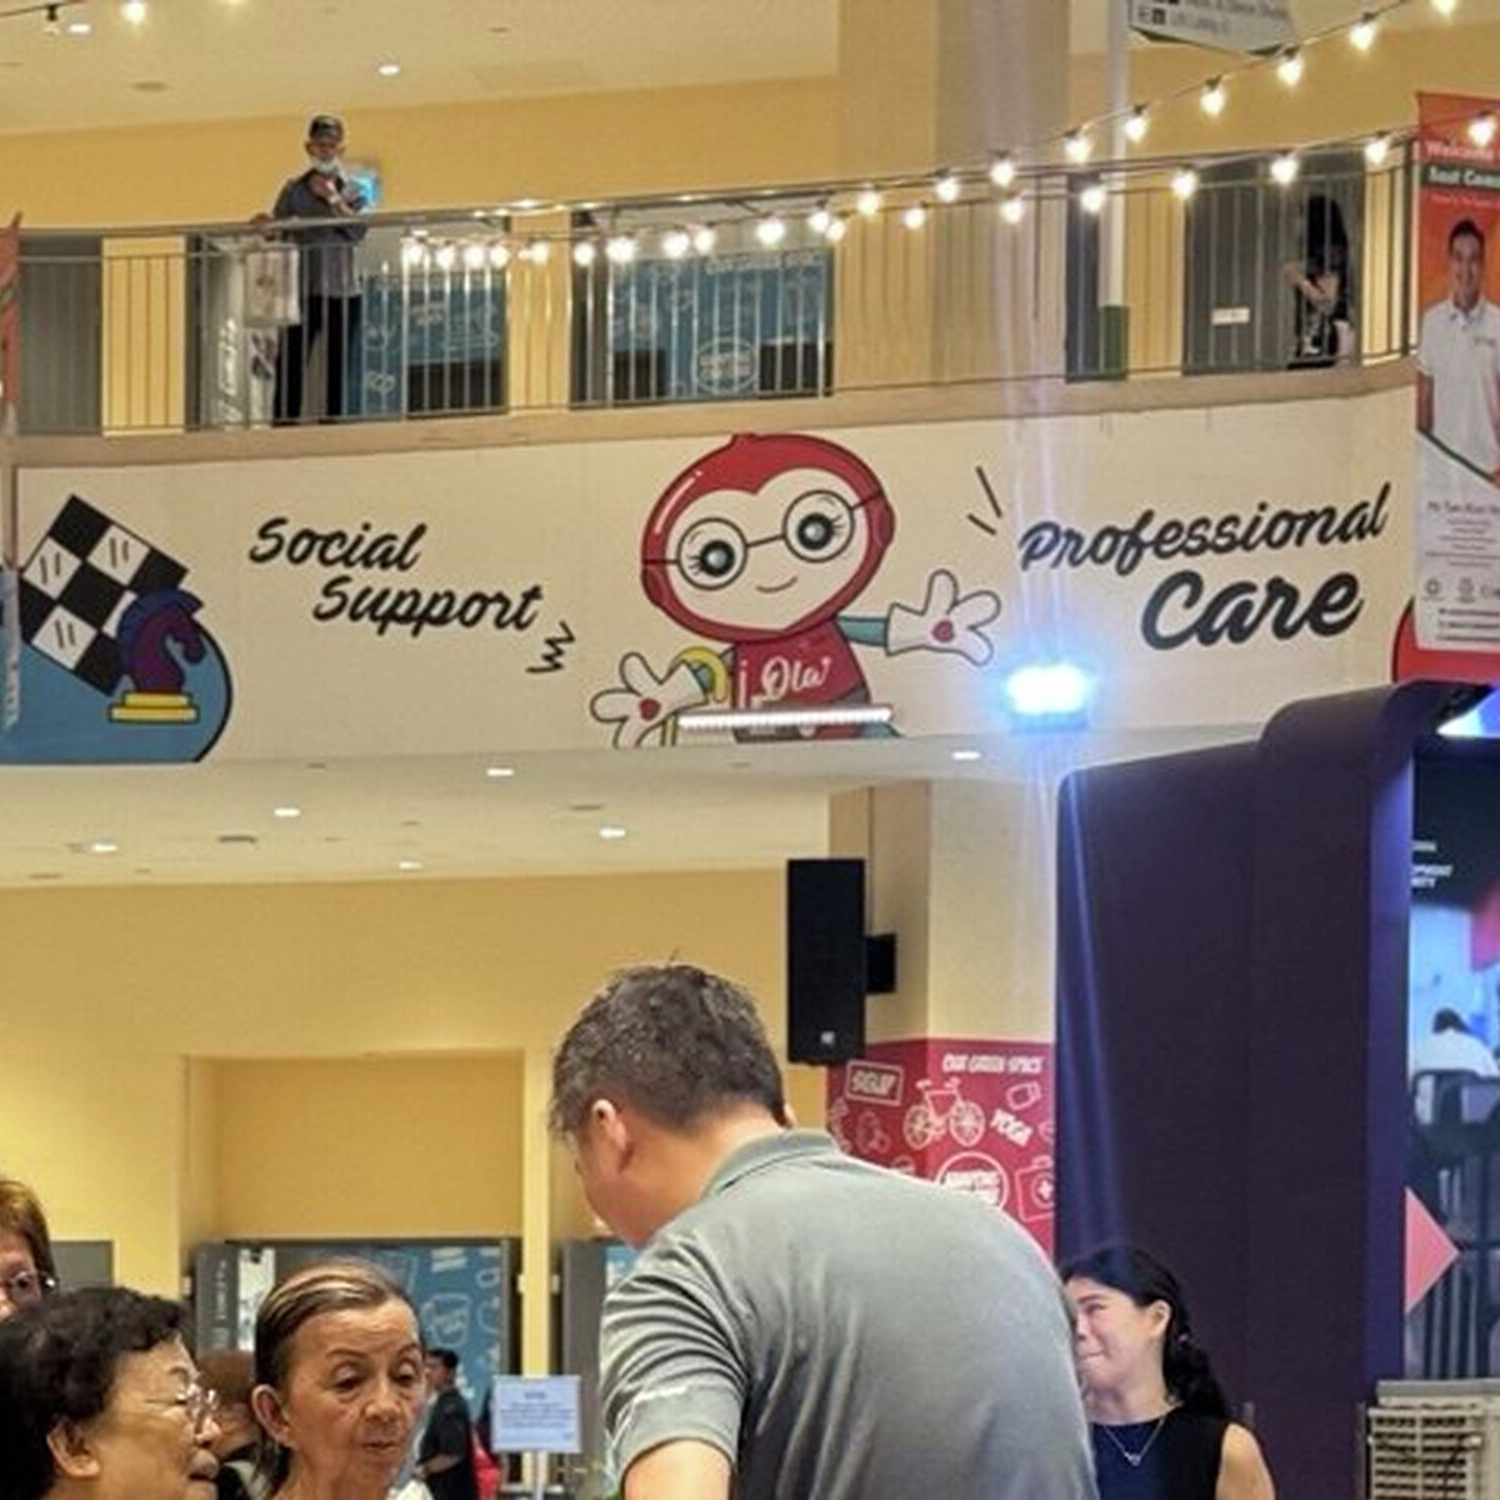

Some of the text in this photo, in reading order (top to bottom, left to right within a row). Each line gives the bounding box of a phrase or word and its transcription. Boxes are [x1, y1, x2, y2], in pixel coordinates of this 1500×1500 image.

[248, 516, 427, 572] Social
[1018, 481, 1391, 577] Professional
[312, 575, 542, 638] Support
[1141, 568, 1364, 651] Care
